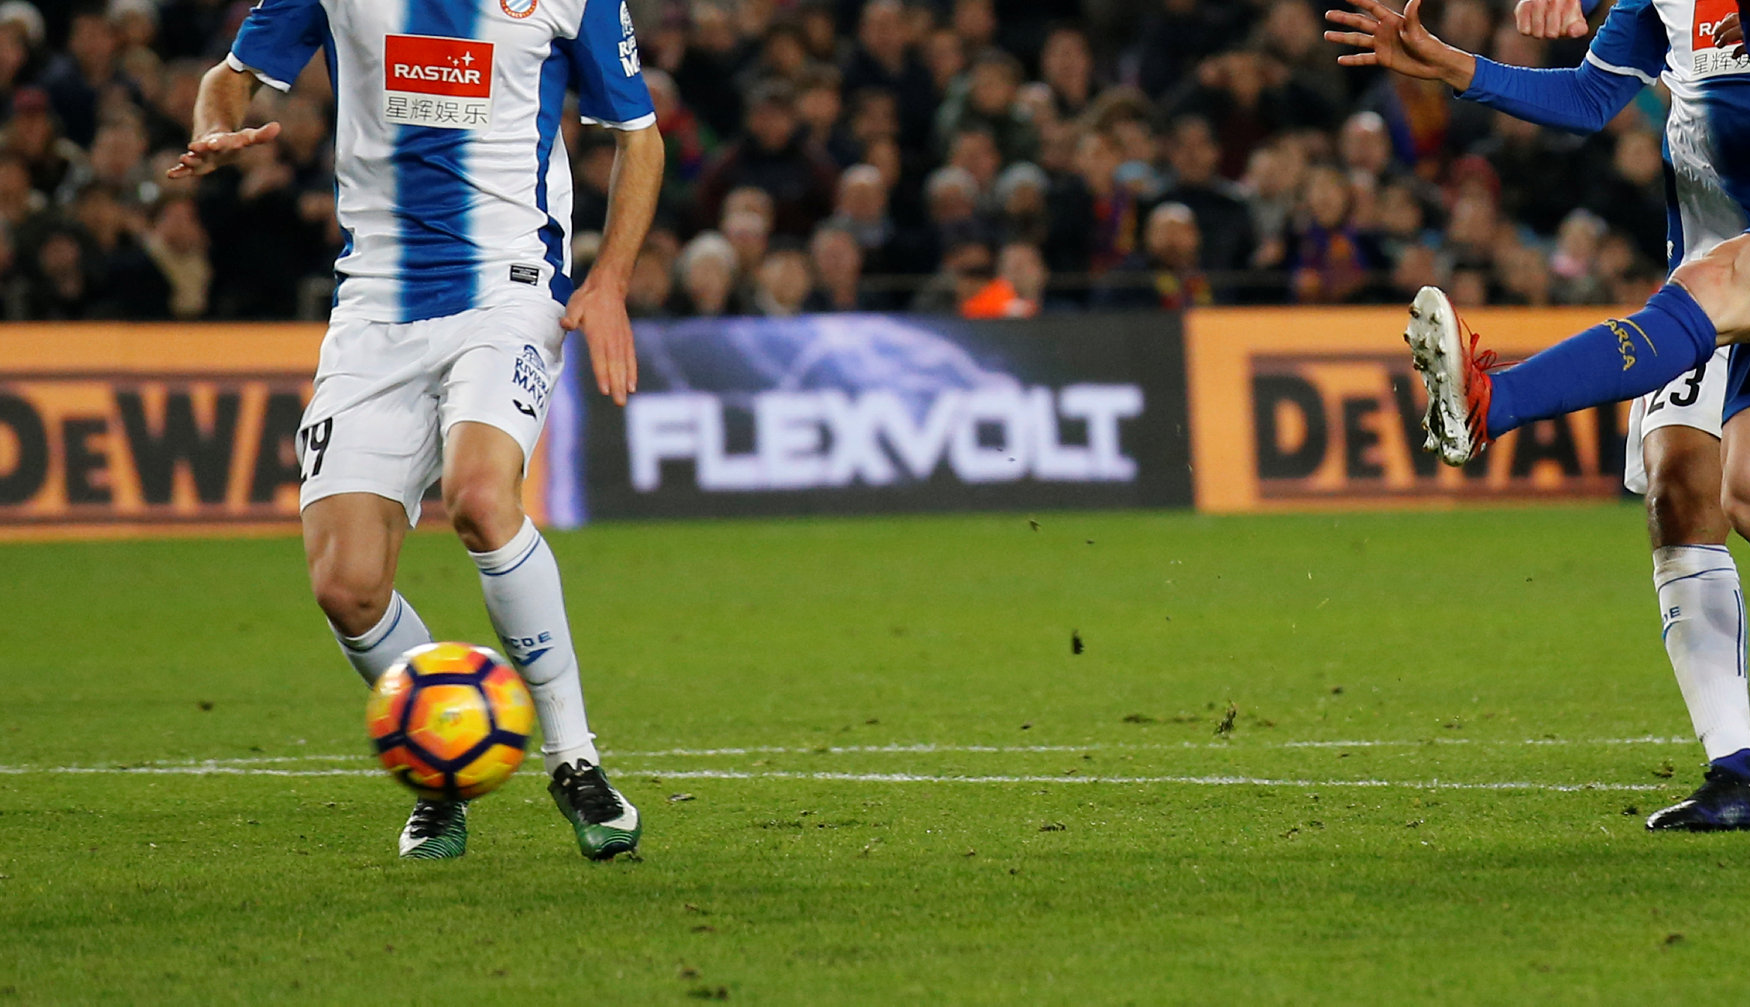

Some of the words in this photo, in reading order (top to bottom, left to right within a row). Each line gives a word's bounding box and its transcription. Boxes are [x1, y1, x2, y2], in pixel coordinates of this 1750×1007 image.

[393, 63, 481, 85] RASTAR
[385, 96, 488, 125] 星辉娱乐
[1603, 318, 1637, 372] ARÇA
[625, 382, 1144, 492] FLEXVOLT
